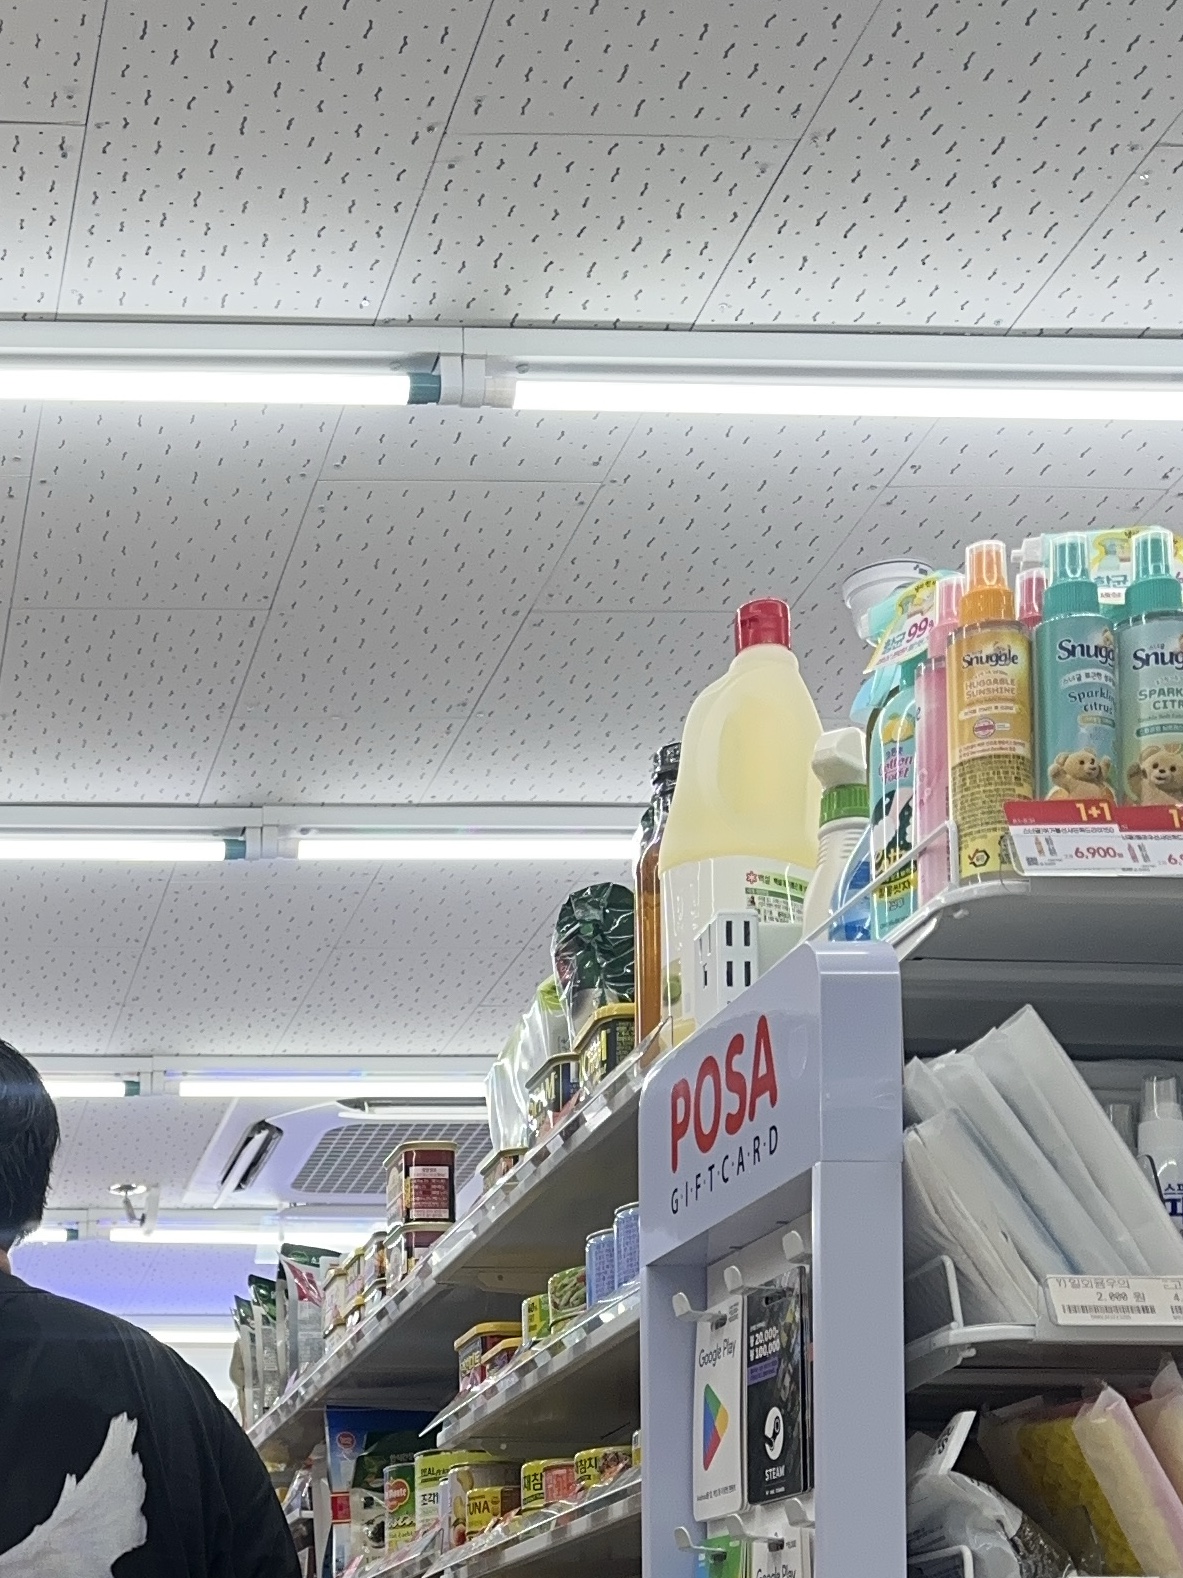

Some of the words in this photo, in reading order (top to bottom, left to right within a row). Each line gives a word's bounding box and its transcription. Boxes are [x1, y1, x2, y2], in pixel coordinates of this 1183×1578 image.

[962, 648, 1019, 669] Snuggle
[966, 678, 1016, 689] HUGGABLE
[966, 687, 1016, 700] SUNSHINE
[1076, 802, 1113, 822] 1+1
[1074, 846, 1117, 860] 6,900
[670, 1014, 778, 1174] POSA
[698, 1345, 722, 1370] Google
[720, 1337, 737, 1363] Play
[765, 1464, 786, 1482] STEAM
